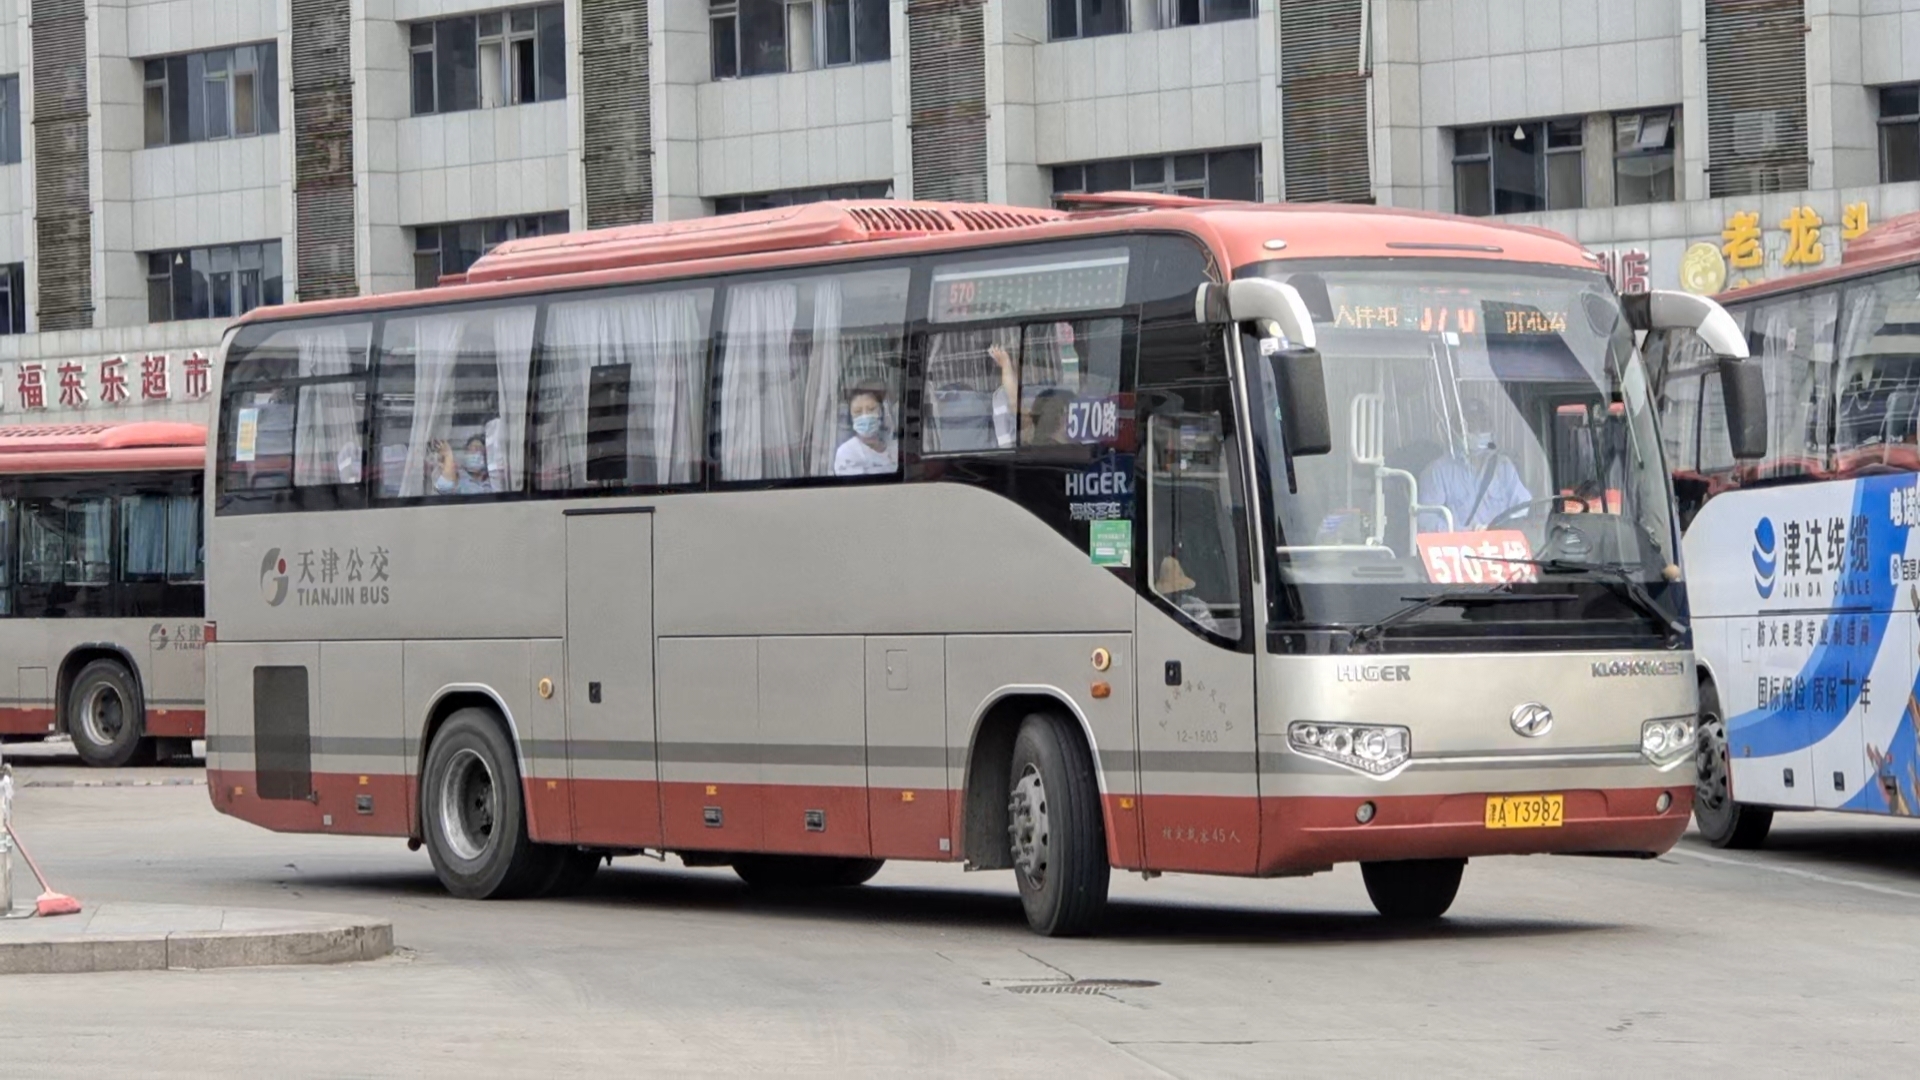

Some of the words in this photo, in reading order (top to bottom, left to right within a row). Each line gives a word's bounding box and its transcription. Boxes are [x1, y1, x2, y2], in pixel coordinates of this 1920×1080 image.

[18, 352, 212, 410] 福东乐超市
[1067, 401, 1117, 439] 570路
[1065, 470, 1128, 496] HIGER
[1783, 514, 1869, 577] 津达线缆
[297, 546, 390, 584] 天津公交
[297, 587, 355, 606] TIANJIN
[360, 586, 390, 605] BUS
[1784, 582, 1800, 598] JIN
[1808, 582, 1822, 597] DA
[1833, 579, 1870, 596] CABLE
[1757, 615, 1870, 647] 防火电缆专业制造商
[1336, 664, 1411, 682] HIGER
[1176, 729, 1219, 743] 12-1503
